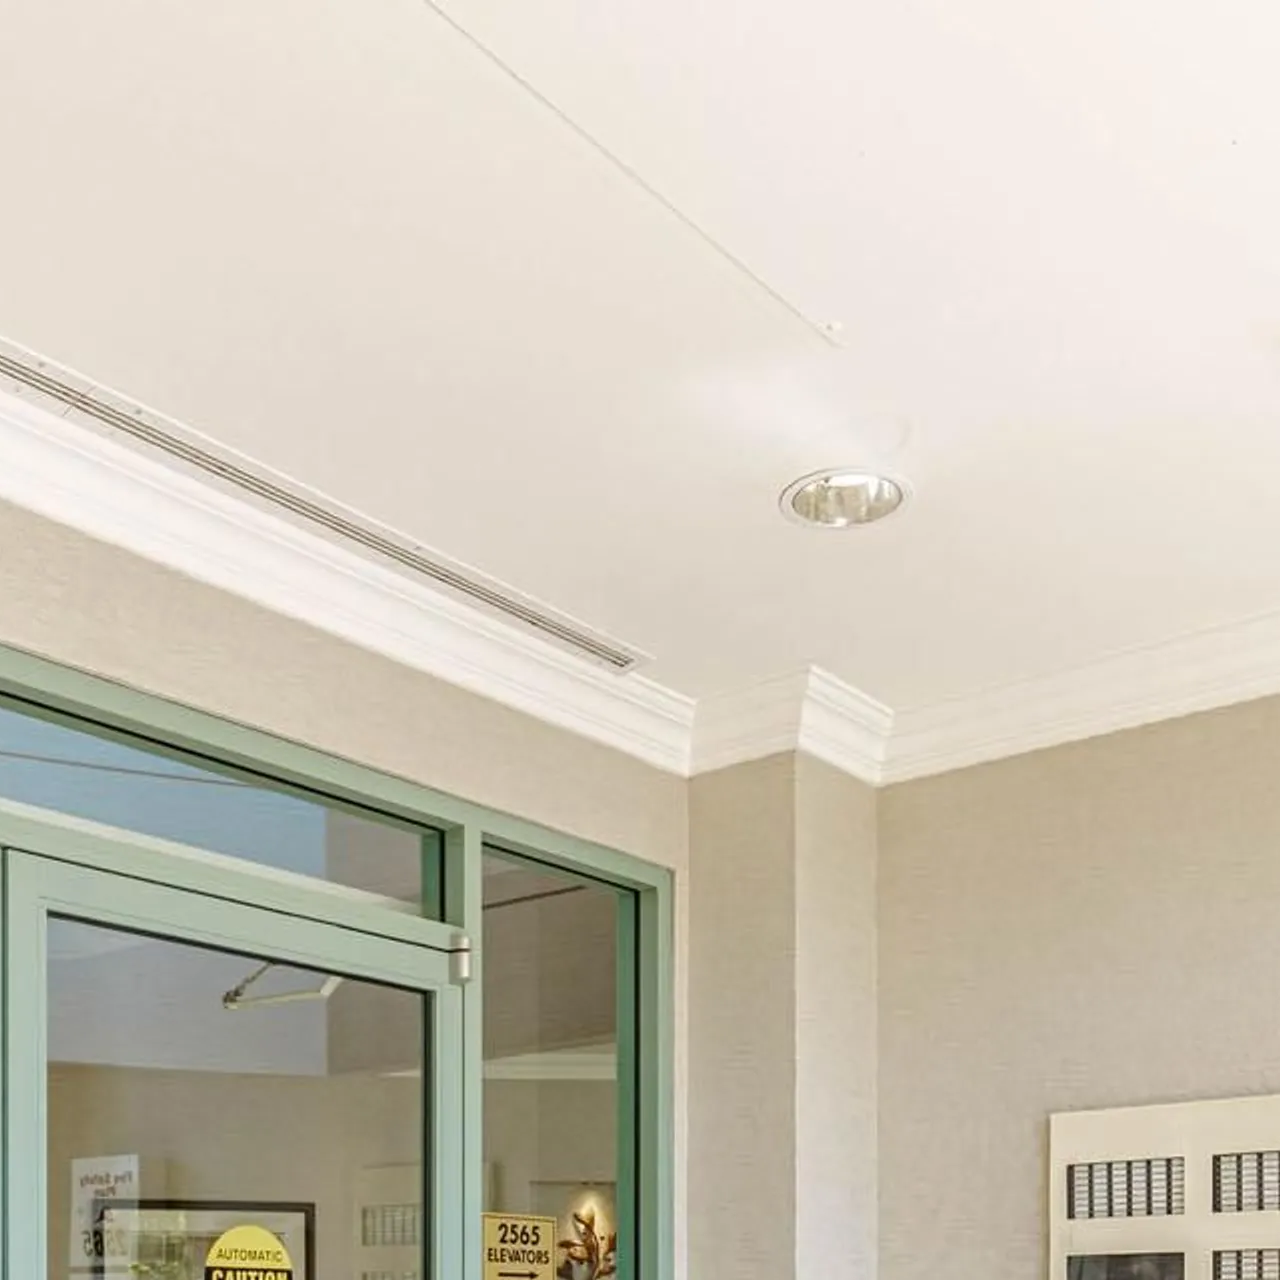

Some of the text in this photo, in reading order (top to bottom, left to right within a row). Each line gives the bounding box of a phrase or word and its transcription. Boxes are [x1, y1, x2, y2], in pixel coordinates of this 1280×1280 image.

[498, 1222, 540, 1246] 2565
[216, 1247, 283, 1262] AUTOMATIC
[487, 1248, 550, 1264] ELEVATORS
